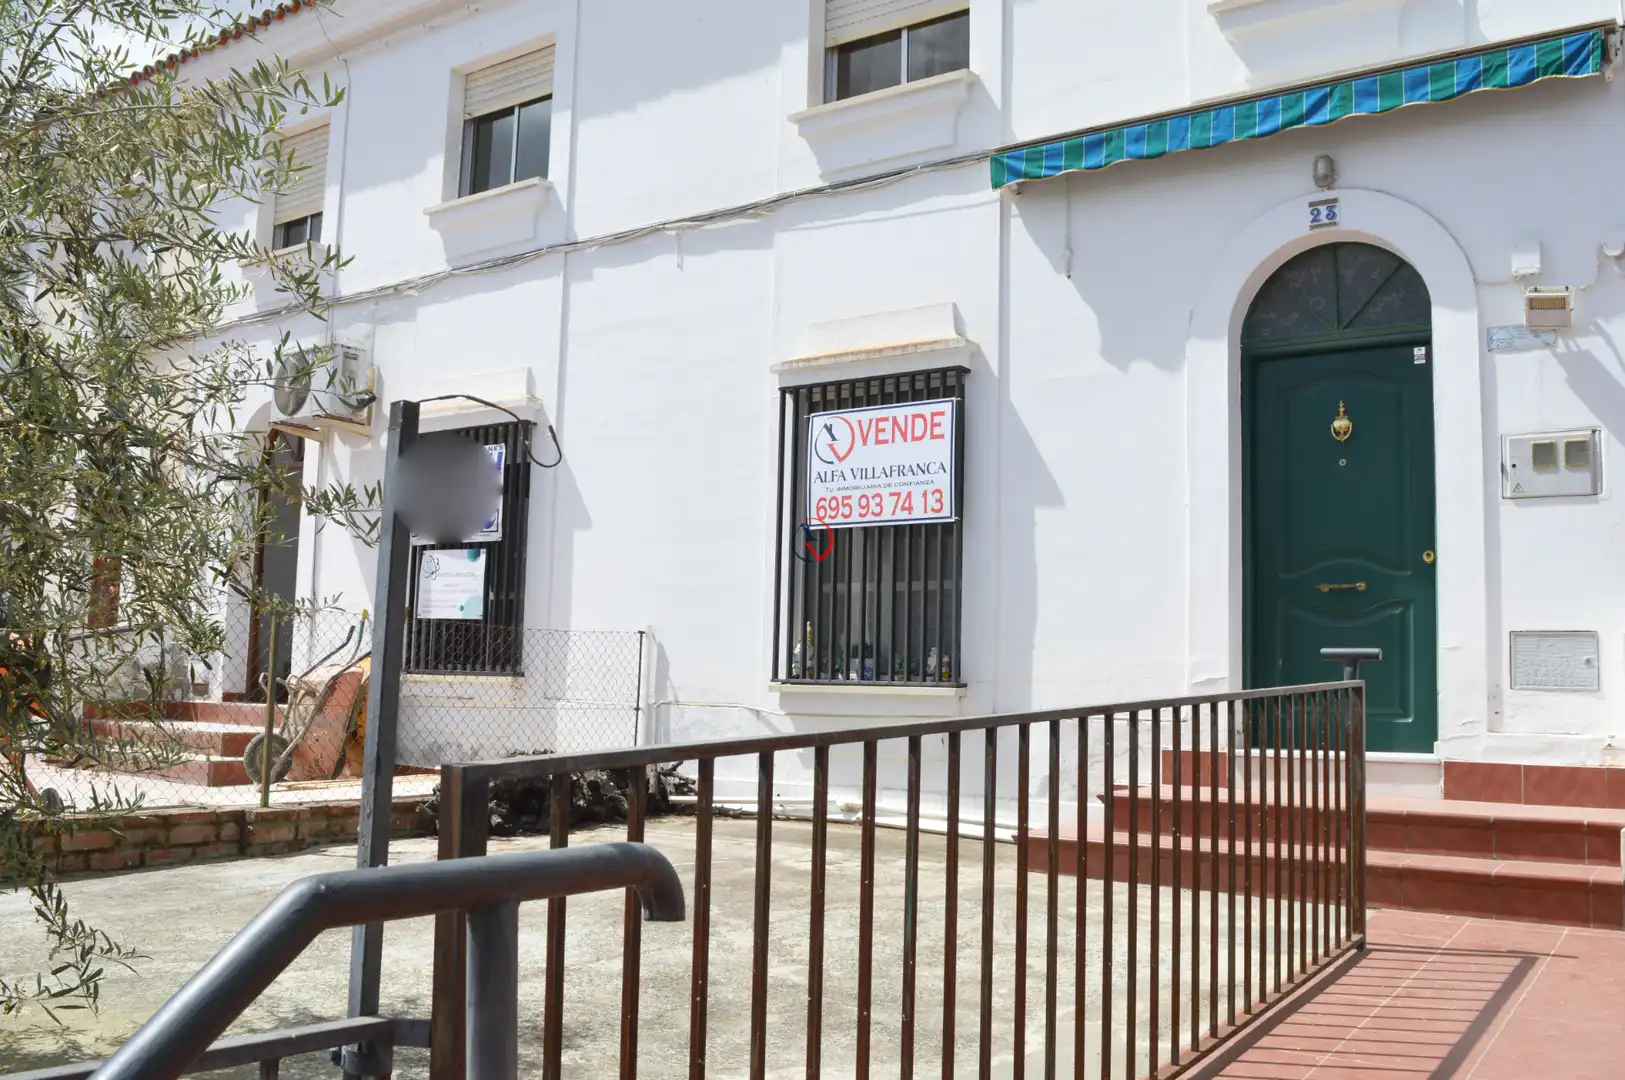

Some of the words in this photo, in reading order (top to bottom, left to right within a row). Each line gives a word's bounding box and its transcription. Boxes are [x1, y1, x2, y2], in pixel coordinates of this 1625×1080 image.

[1310, 205, 1337, 224] 23
[857, 410, 945, 446] VENDE
[814, 469, 847, 484] ALFA
[850, 461, 947, 480] VILLAFRANCA
[894, 479, 935, 487] CONFIANZA
[816, 495, 853, 520] 695
[858, 493, 883, 519] 93
[889, 491, 913, 516] 74
[922, 488, 944, 514] 13
